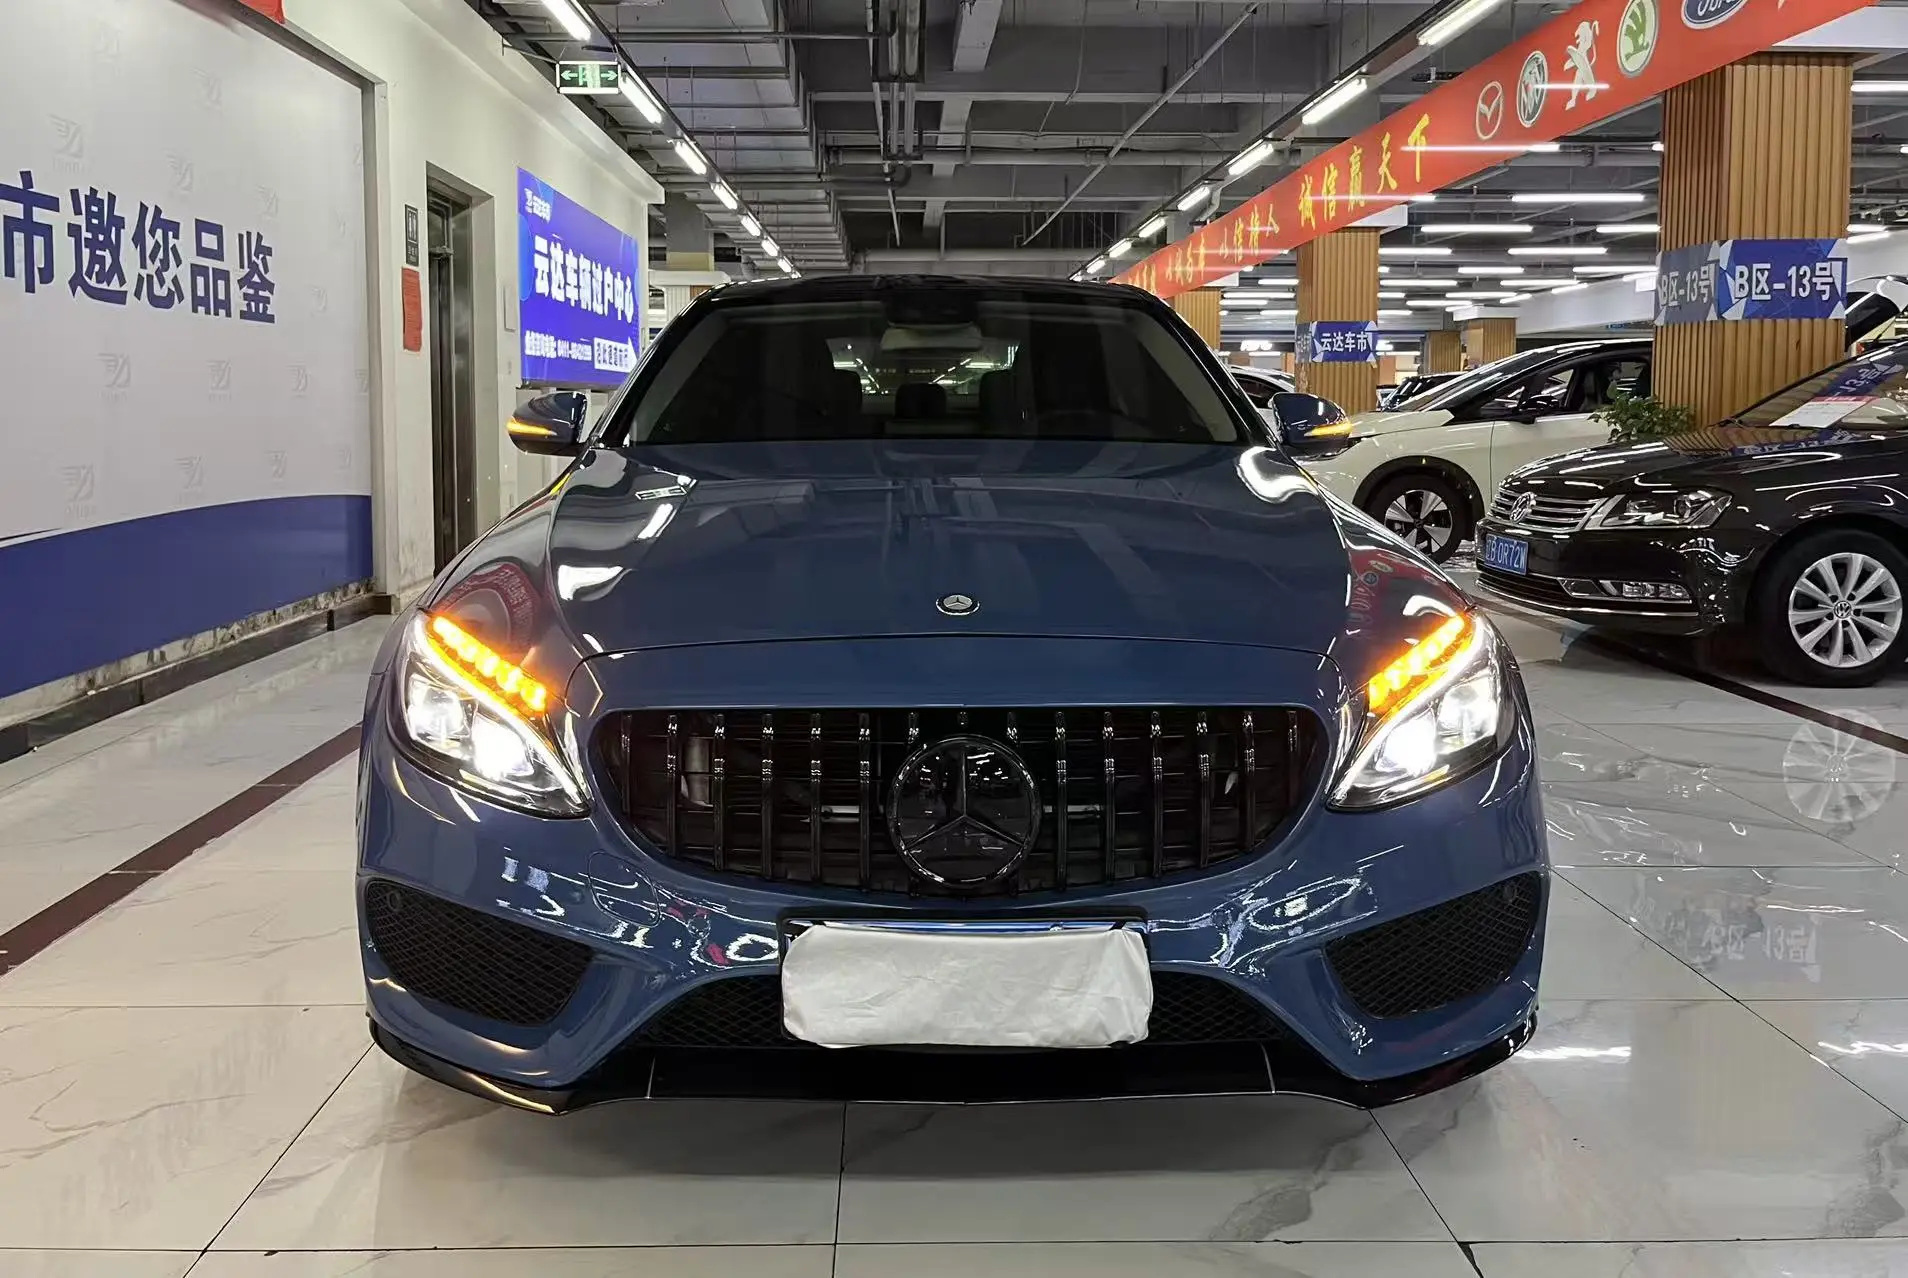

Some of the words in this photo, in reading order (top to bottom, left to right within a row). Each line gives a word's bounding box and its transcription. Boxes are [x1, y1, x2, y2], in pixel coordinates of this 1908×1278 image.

[0, 170, 275, 323] 市邀您品鉴
[533, 234, 634, 323] 云达车辆过户中心
[1660, 264, 1711, 307] B区-13号
[1735, 260, 1833, 301] B区-13号
[1320, 331, 1368, 352] 云达车市
